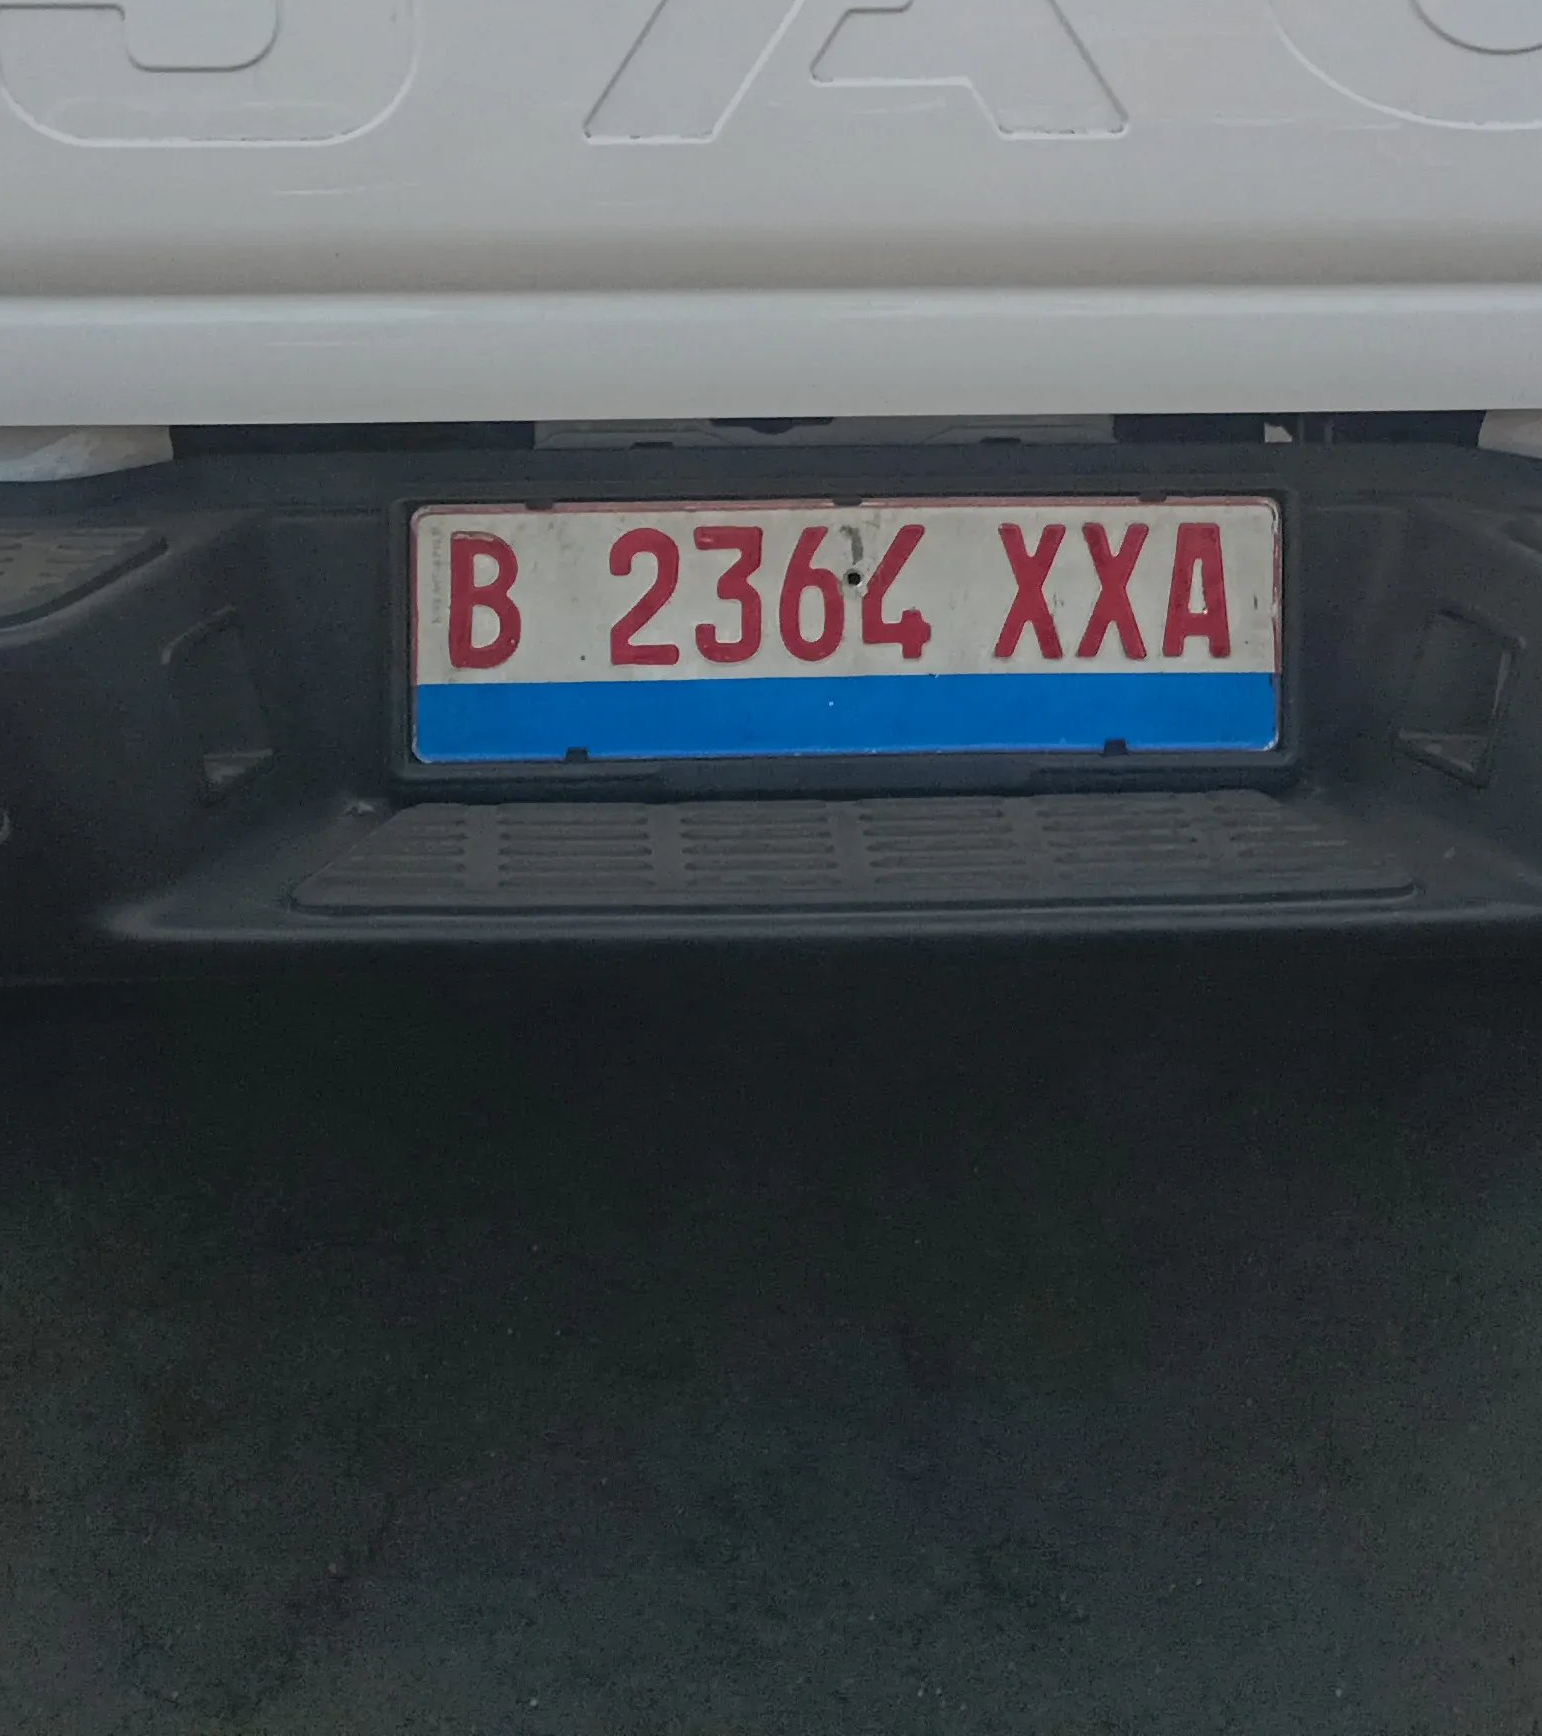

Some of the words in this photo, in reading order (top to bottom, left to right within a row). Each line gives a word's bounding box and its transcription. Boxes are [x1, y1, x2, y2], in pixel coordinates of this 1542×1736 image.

[448, 530, 522, 669] B
[609, 523, 932, 666] 2364
[994, 522, 1231, 660] XXA
